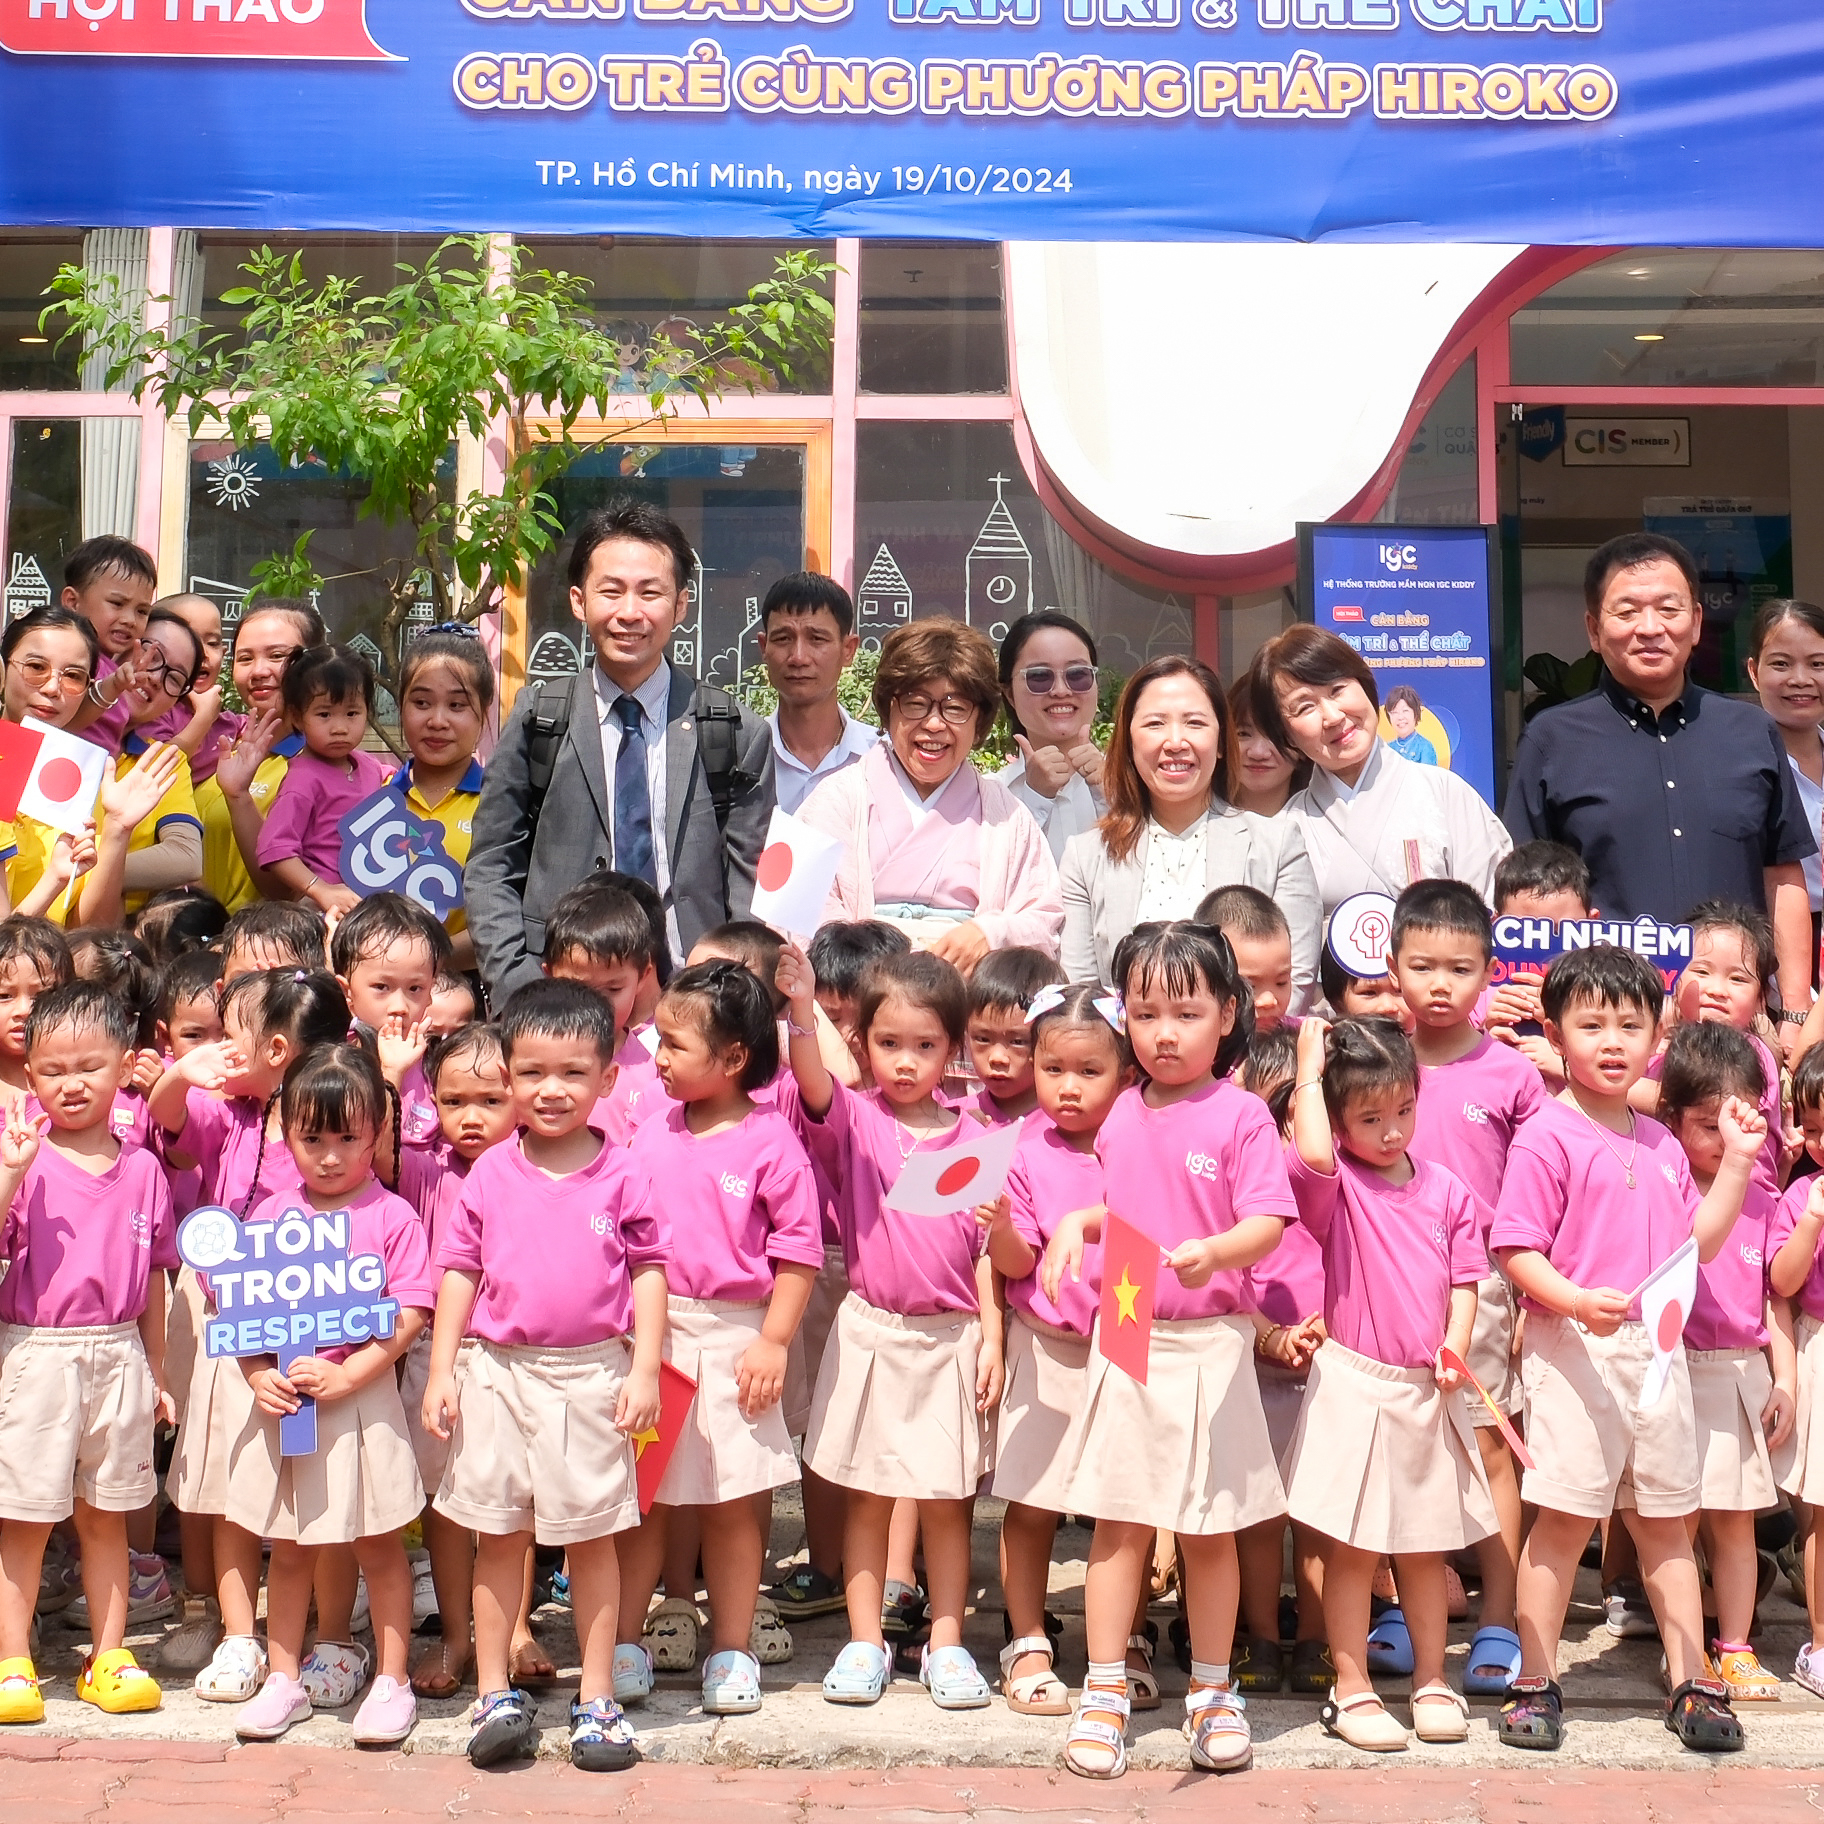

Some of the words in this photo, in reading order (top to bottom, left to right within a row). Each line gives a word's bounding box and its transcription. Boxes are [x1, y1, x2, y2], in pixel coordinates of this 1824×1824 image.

[453, 53, 598, 110] CHO
[600, 39, 730, 111] TRẺ
[738, 44, 917, 113] CÙNG
[920, 52, 1185, 116] PHƯƠNG
[1194, 50, 1371, 118] PHÁP
[1374, 64, 1618, 120] HIROKO
[535, 161, 580, 187] TP.
[593, 157, 636, 187] Hồ
[648, 160, 700, 189] Chí
[709, 162, 793, 193] Minh,
[804, 165, 878, 196] ngày
[892, 165, 1073, 195] 19/10/2024
[1575, 428, 1627, 455] CIS
[1631, 437, 1670, 446] MEMBER
[245, 1210, 347, 1259] TÔN
[212, 1256, 381, 1309] TRỌNG
[209, 1302, 396, 1356] RESPECT
